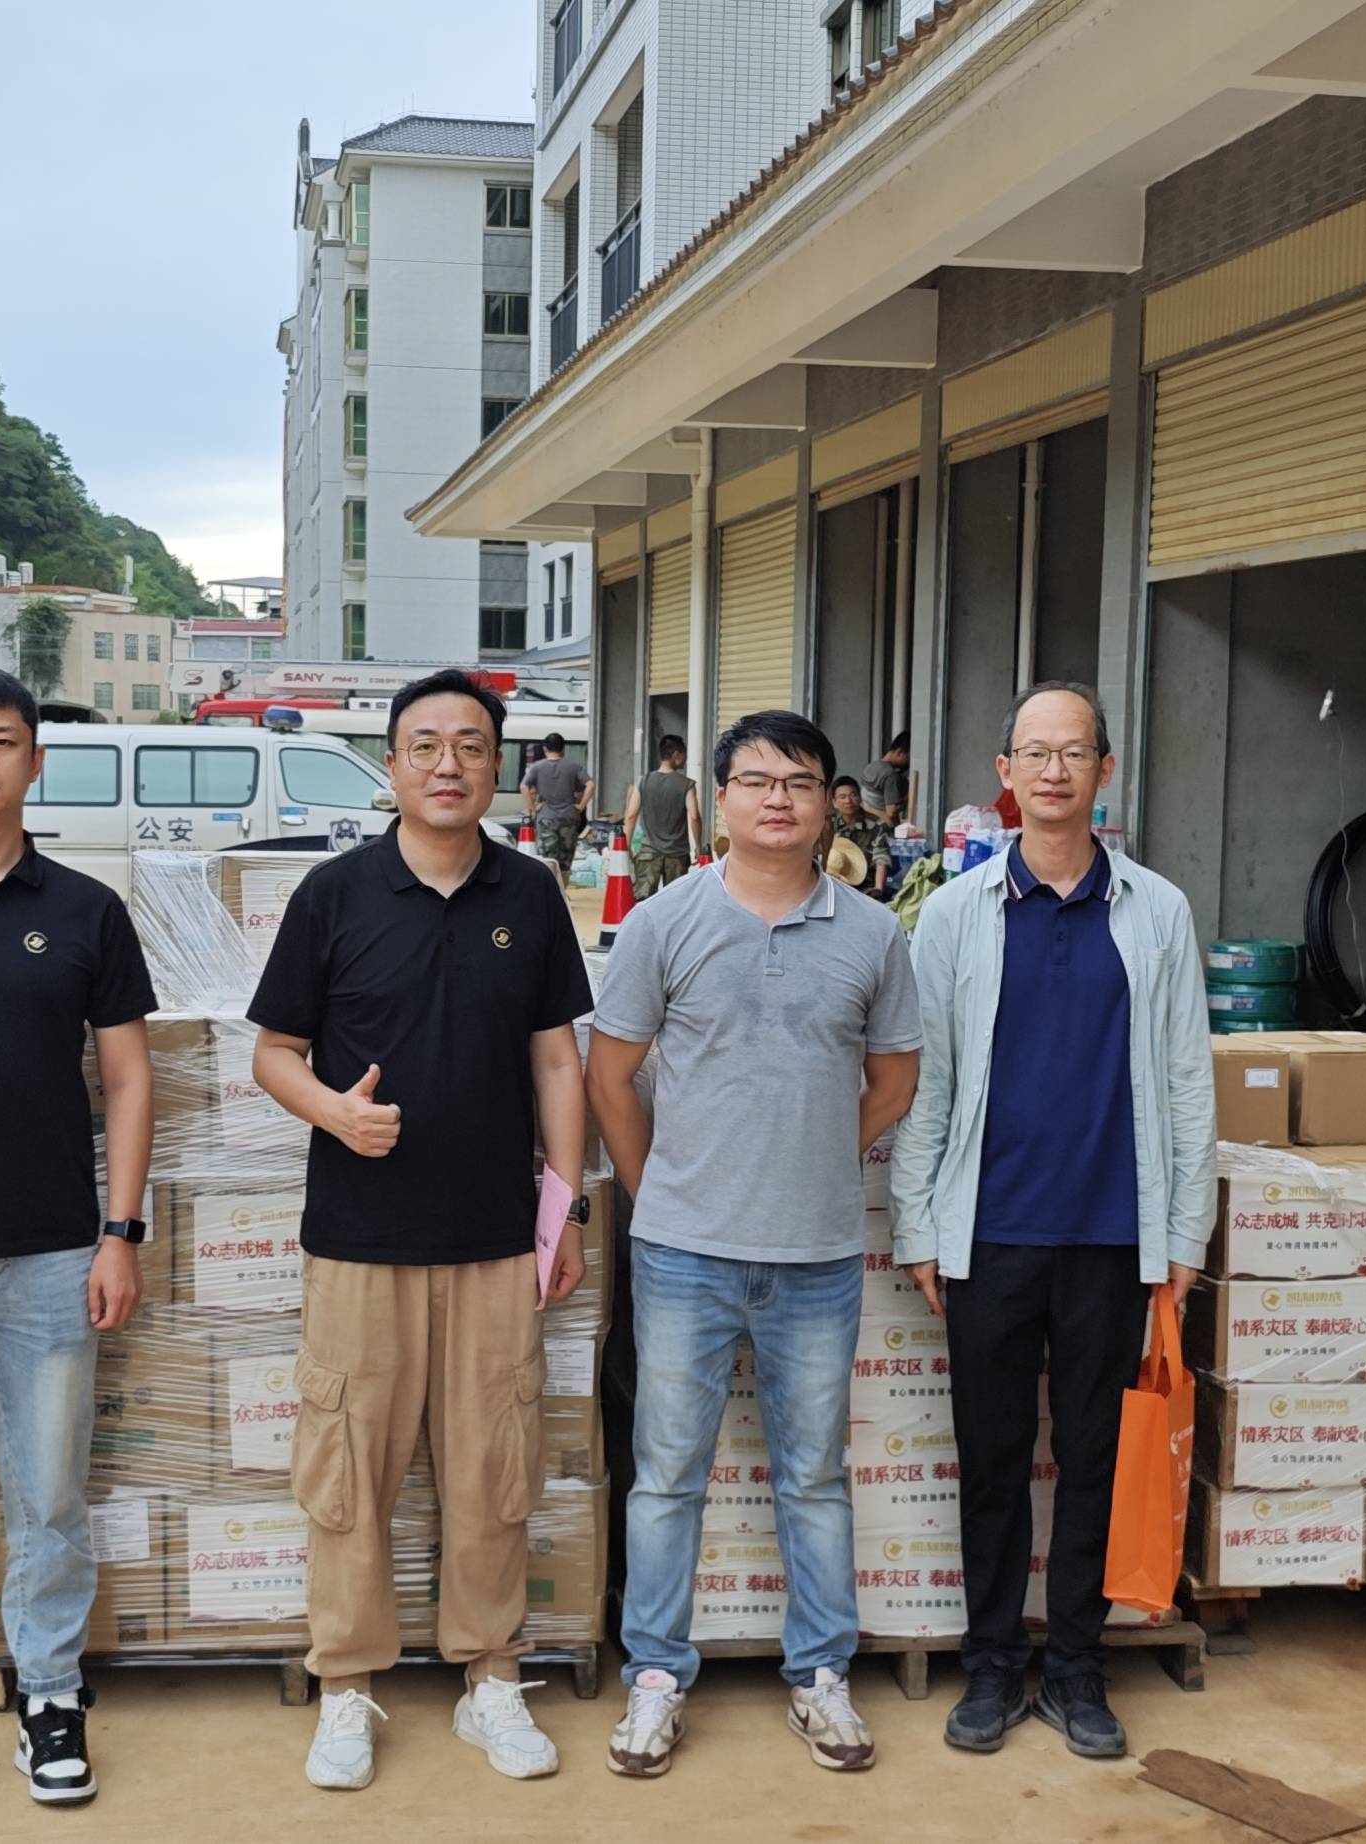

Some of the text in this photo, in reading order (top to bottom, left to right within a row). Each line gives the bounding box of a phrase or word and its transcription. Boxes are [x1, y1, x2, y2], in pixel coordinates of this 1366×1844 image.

[283, 672, 324, 683] SANY
[136, 816, 194, 842] 公安
[1233, 1212, 1299, 1230] 众志成城
[1232, 1318, 1298, 1337] 情系灾区
[854, 1358, 923, 1377] 情系灾区
[1240, 1425, 1305, 1444] 情系灾区
[855, 1464, 924, 1485] 情系灾区
